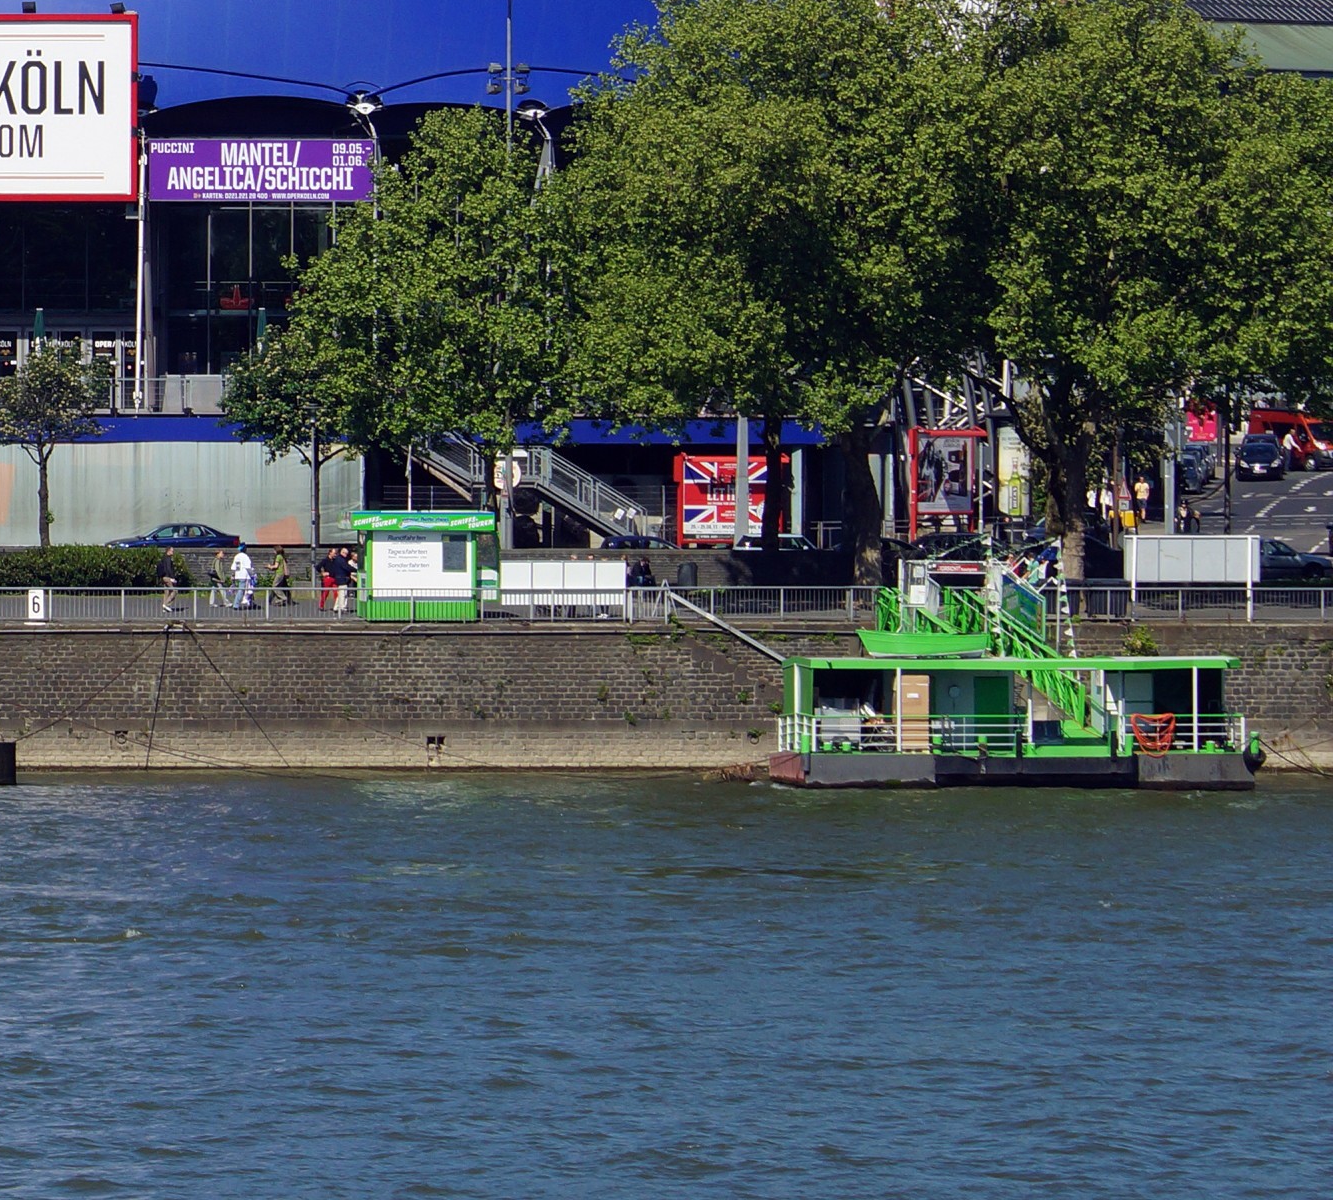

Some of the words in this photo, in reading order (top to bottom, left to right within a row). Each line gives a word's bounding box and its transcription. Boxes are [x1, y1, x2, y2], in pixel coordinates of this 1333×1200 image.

[150, 142, 195, 154] PUCCINI
[332, 143, 371, 154] 09.05.-
[221, 141, 301, 167] MANTEL/
[332, 155, 366, 166] 01.06.
[167, 166, 354, 191] ANGELICA/SCHICCHI
[353, 516, 382, 527] SCHIFFS-
[371, 518, 398, 529] TOUREN
[450, 516, 479, 527] SCHIFFS-
[468, 519, 494, 529] TOUREN
[32, 595, 40, 613] 6
